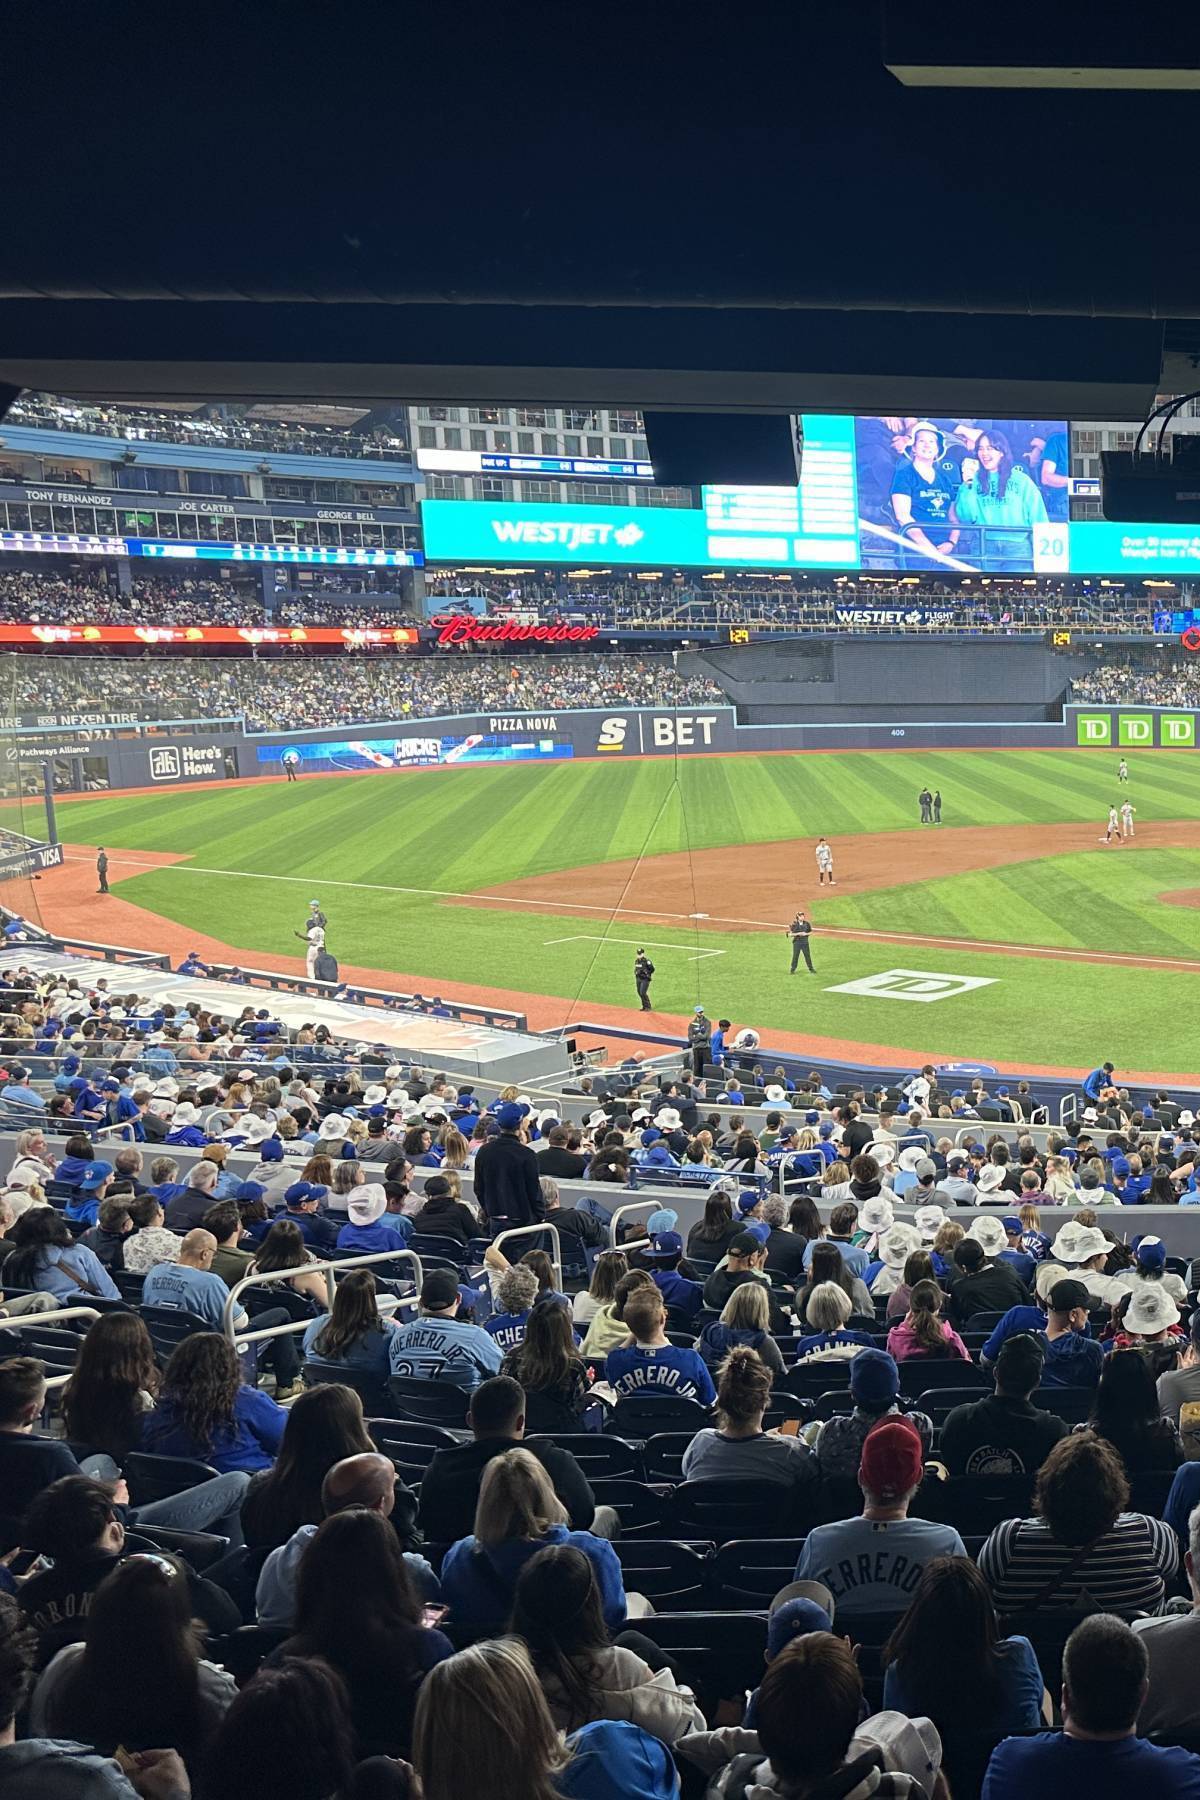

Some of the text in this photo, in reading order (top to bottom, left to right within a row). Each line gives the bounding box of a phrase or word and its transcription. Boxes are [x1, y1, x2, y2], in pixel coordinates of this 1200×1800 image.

[26, 490, 112, 505] TONY FERNANDEZ
[179, 502, 235, 513] JOE CARTER
[317, 510, 375, 521] GEORGE BELL
[492, 521, 613, 551] WESTJET
[1039, 538, 1063, 556] 20
[836, 610, 954, 624] WESTJET FLIGHT
[431, 615, 600, 643] Budweiser
[61, 713, 105, 726] NEXEN
[108, 712, 138, 723] TIRE
[490, 717, 557, 732] PIZZA NOVA
[653, 716, 718, 746] BET
[890, 729, 905, 737] 400
[1081, 720, 1108, 739] TD
[1122, 720, 1149, 739] TD
[1164, 720, 1191, 739] TD
[20, 746, 90, 757] Pathways Alliance
[183, 746, 222, 761] Here's
[183, 761, 216, 775] How.
[38, 847, 61, 867] VISA
[869, 974, 967, 994] TD
[390, 1329, 446, 1361] GUERRERO
[615, 1365, 681, 1396] ERRERO
[819, 1551, 924, 1599] ERRERO
[33, 1591, 95, 1630] ORON
